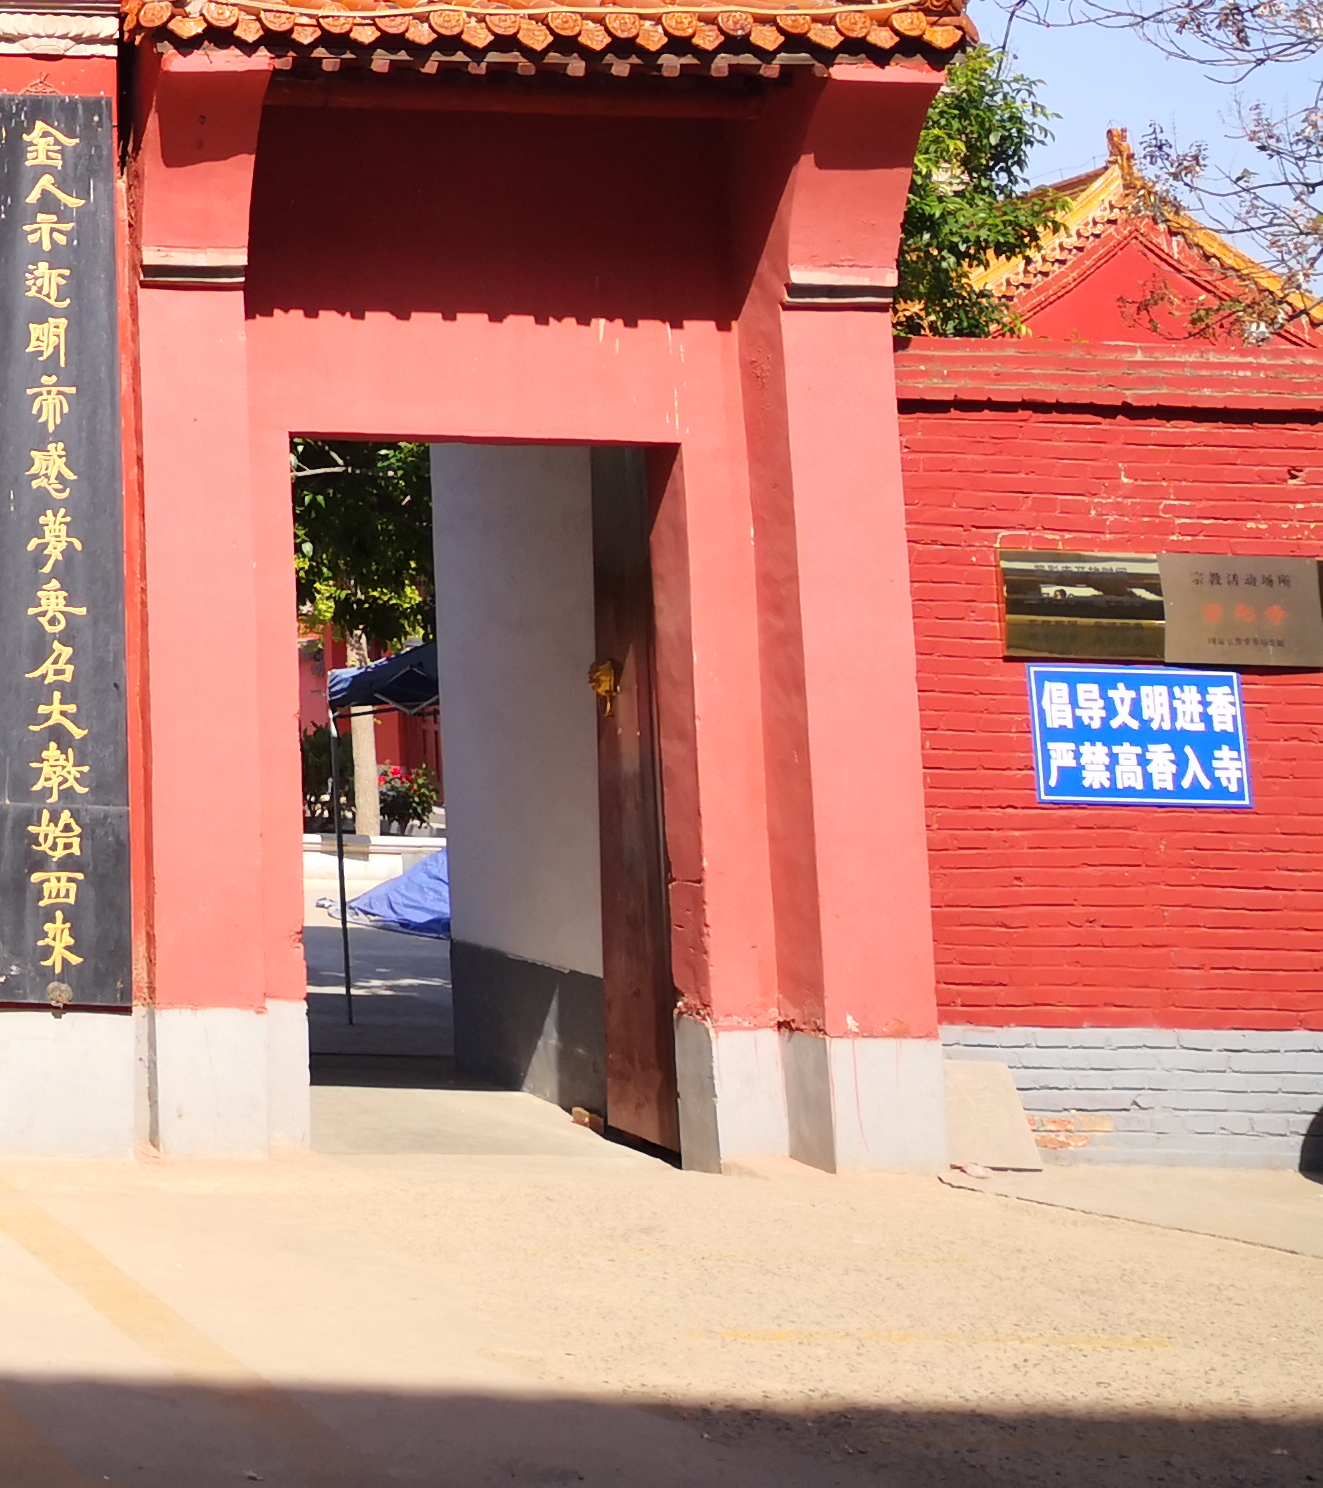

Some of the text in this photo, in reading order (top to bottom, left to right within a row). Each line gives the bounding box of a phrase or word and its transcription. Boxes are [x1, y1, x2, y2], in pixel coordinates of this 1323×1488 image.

[1189, 570, 1293, 590] 宗教活动场所
[1040, 680, 1238, 733] 倡导文明进香
[1046, 740, 1243, 794] 严禁高香入寺
